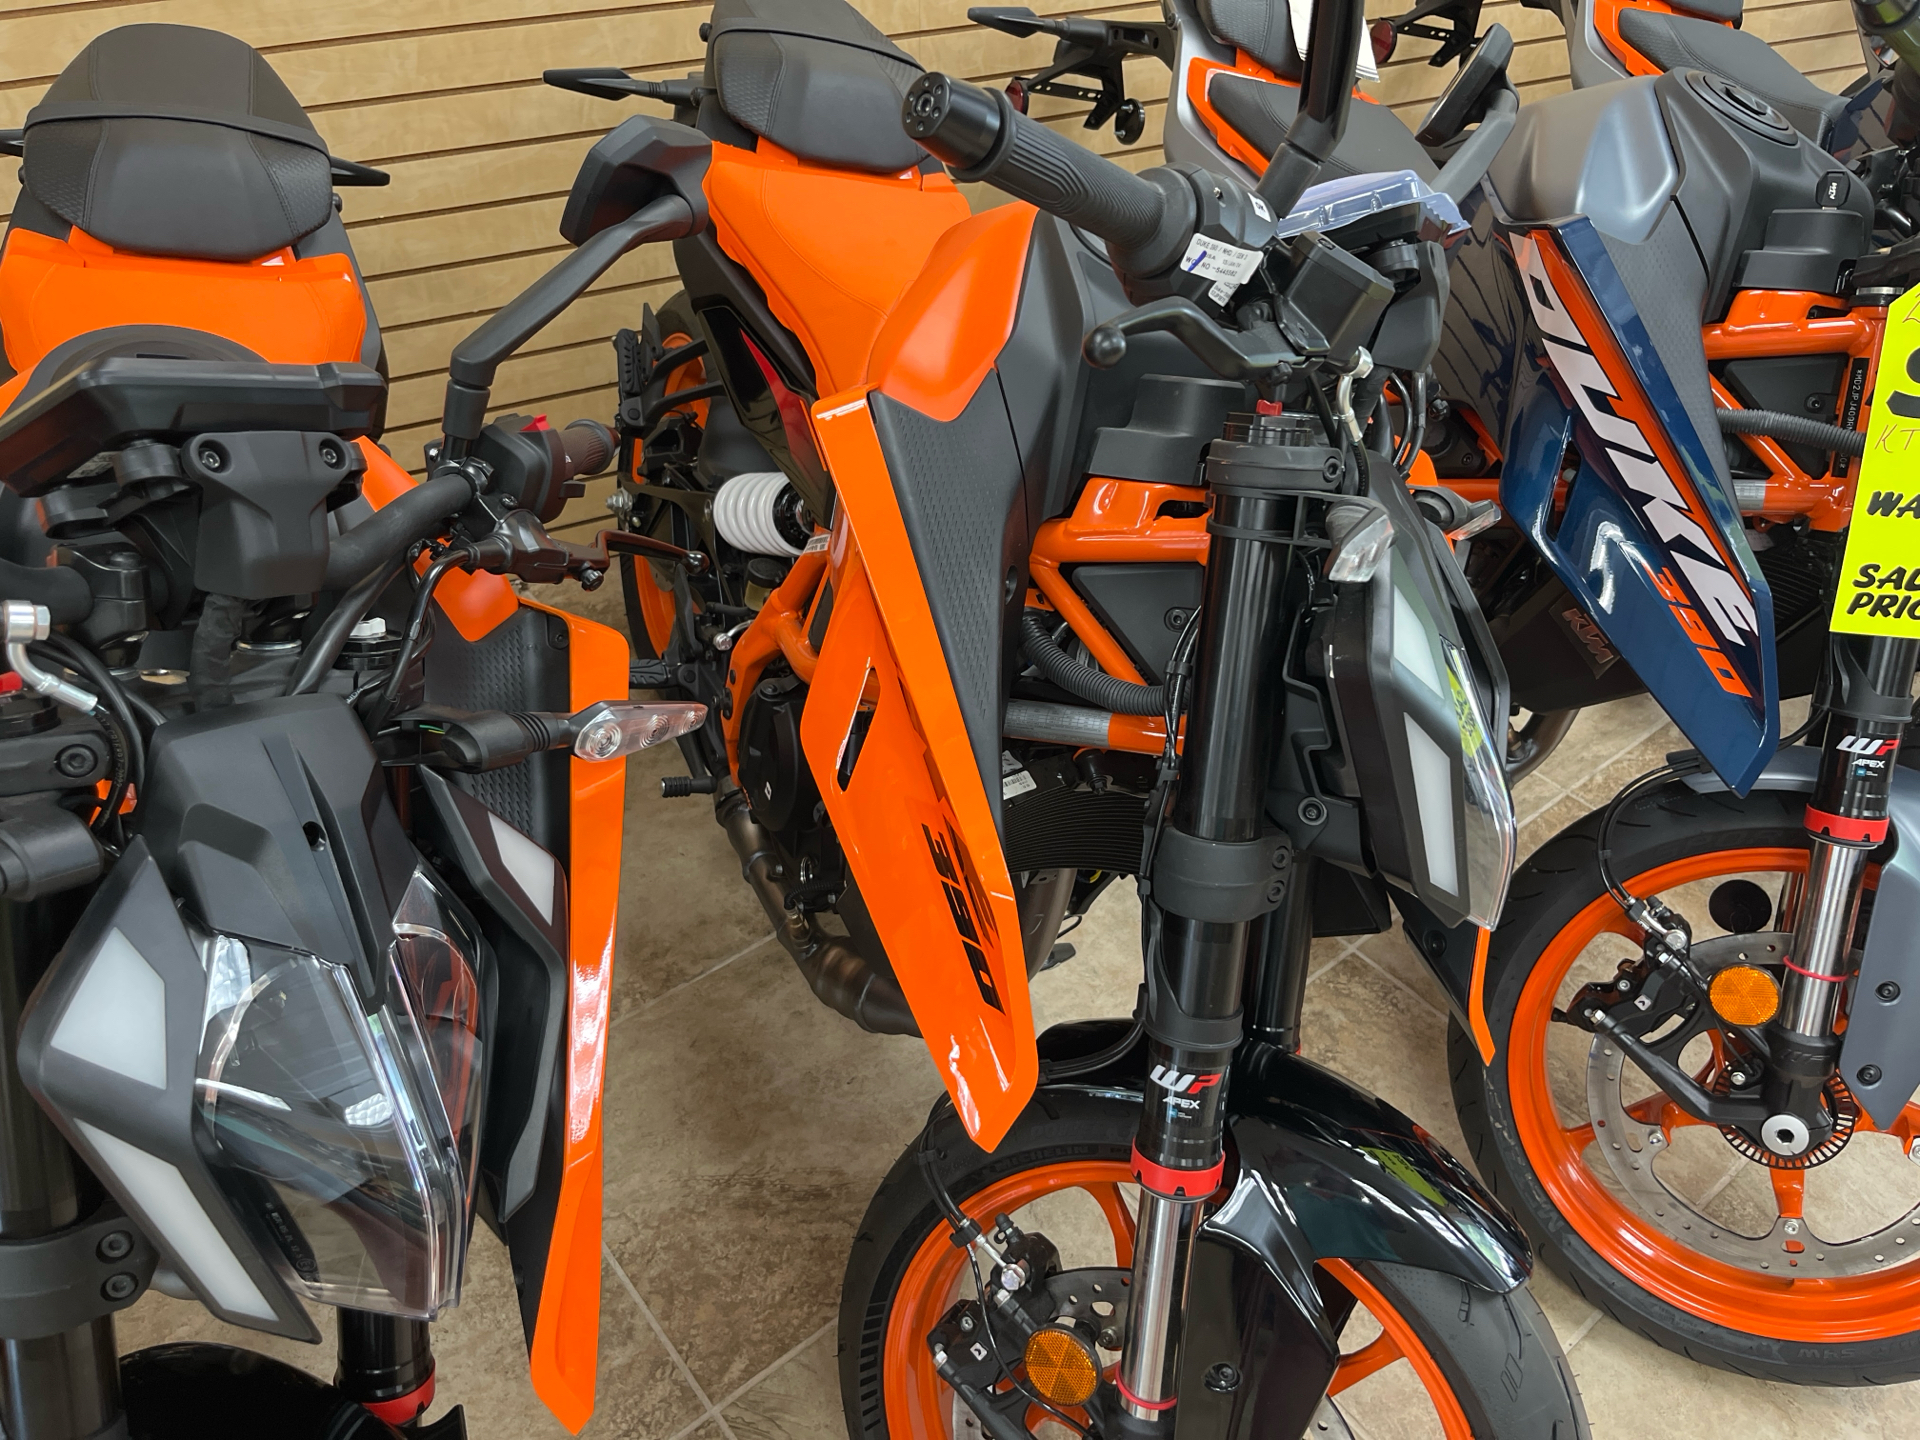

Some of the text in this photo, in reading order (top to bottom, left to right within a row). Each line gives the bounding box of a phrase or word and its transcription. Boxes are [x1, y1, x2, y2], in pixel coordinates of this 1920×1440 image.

[1196, 239, 1210, 249] DUKE
[1509, 231, 1761, 647] DUKE
[1561, 608, 1614, 664] KTM
[1649, 563, 1753, 699] 390
[1836, 735, 1900, 756] WP
[1851, 758, 1885, 769] APEX
[921, 823, 1006, 1016] 390
[1149, 1064, 1222, 1094] WP
[1162, 1095, 1200, 1110] APEX
